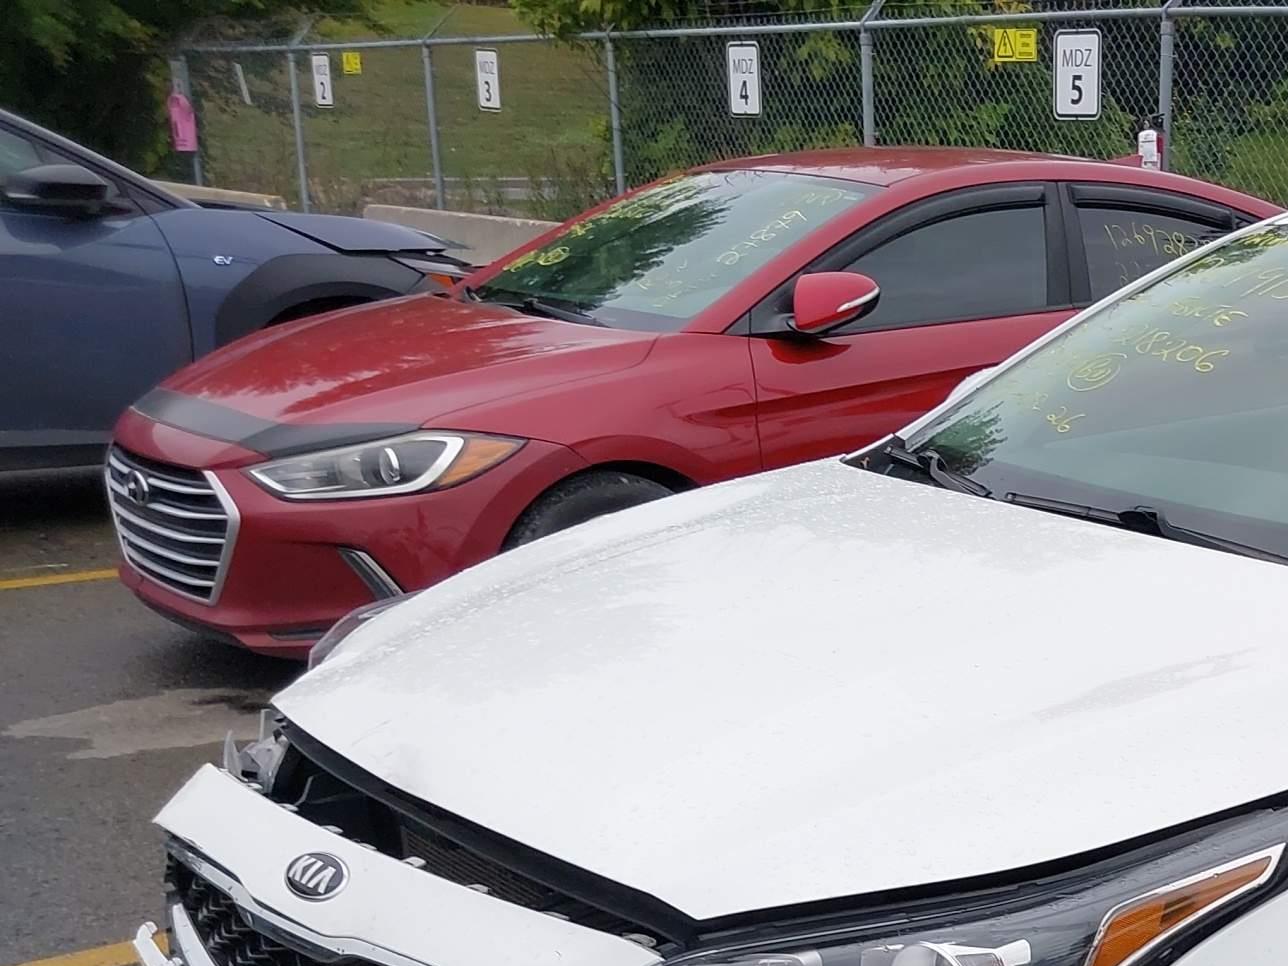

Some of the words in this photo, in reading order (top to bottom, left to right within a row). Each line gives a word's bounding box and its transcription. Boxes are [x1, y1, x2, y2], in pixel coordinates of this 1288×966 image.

[733, 58, 754, 74] MDZ
[1062, 48, 1093, 68] MDZ
[319, 81, 327, 100] 2
[483, 80, 492, 102] 3
[739, 79, 750, 106] 4
[1070, 74, 1084, 105] 5
[213, 255, 233, 265] EV
[288, 855, 337, 894] KIA
